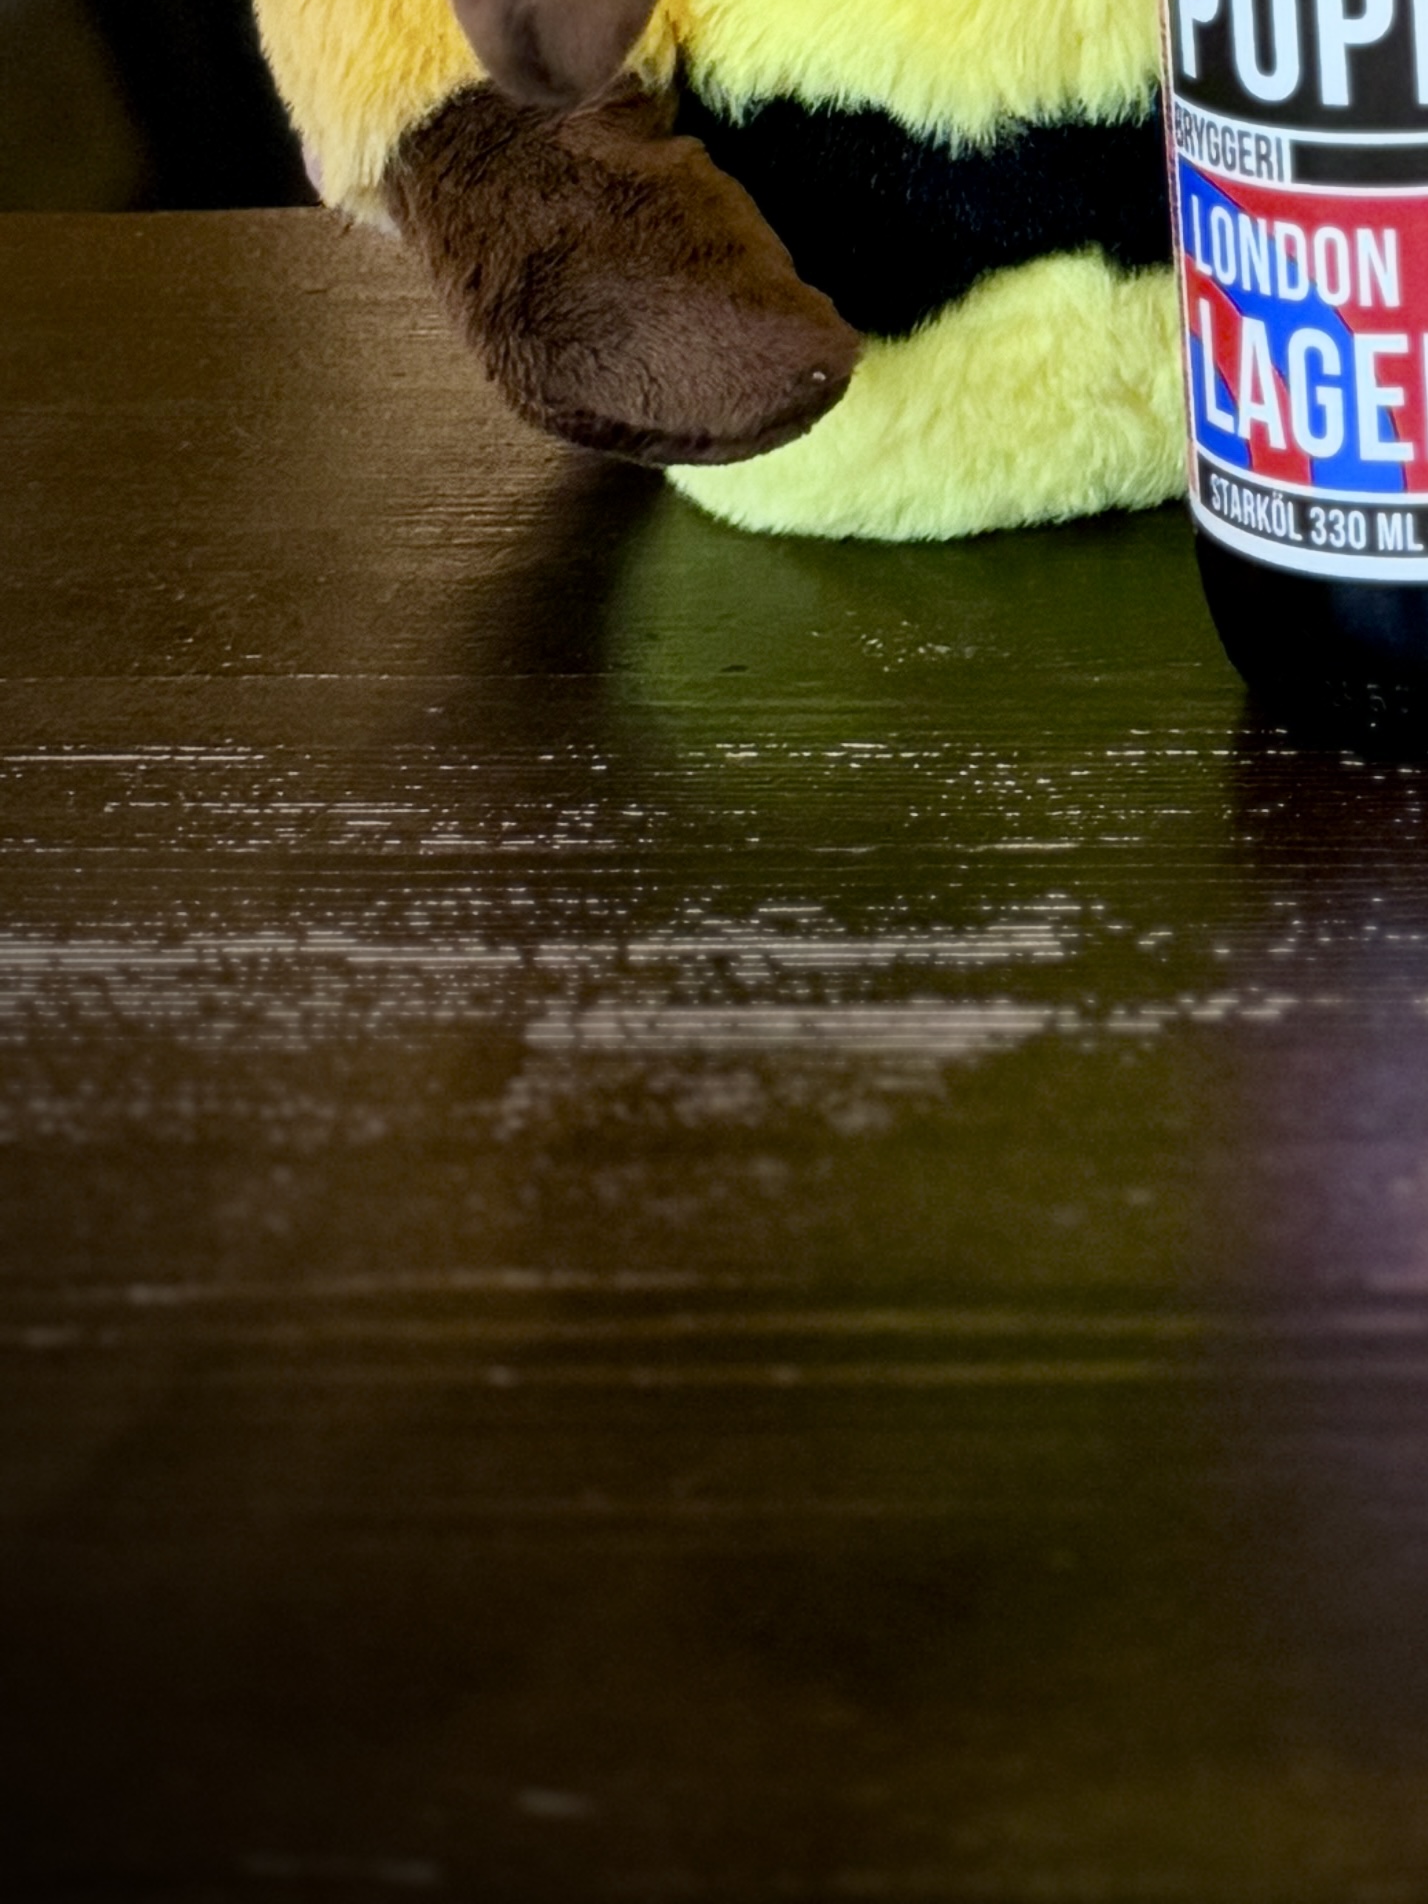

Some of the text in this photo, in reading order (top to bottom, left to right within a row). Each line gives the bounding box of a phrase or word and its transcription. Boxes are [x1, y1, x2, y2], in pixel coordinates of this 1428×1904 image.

[1175, 104, 1285, 183] BRYGGERI
[1191, 194, 1402, 308] LONDON
[1209, 474, 1303, 542] STARKÖL
[1310, 510, 1367, 550] 330
[1378, 515, 1423, 552] ML
